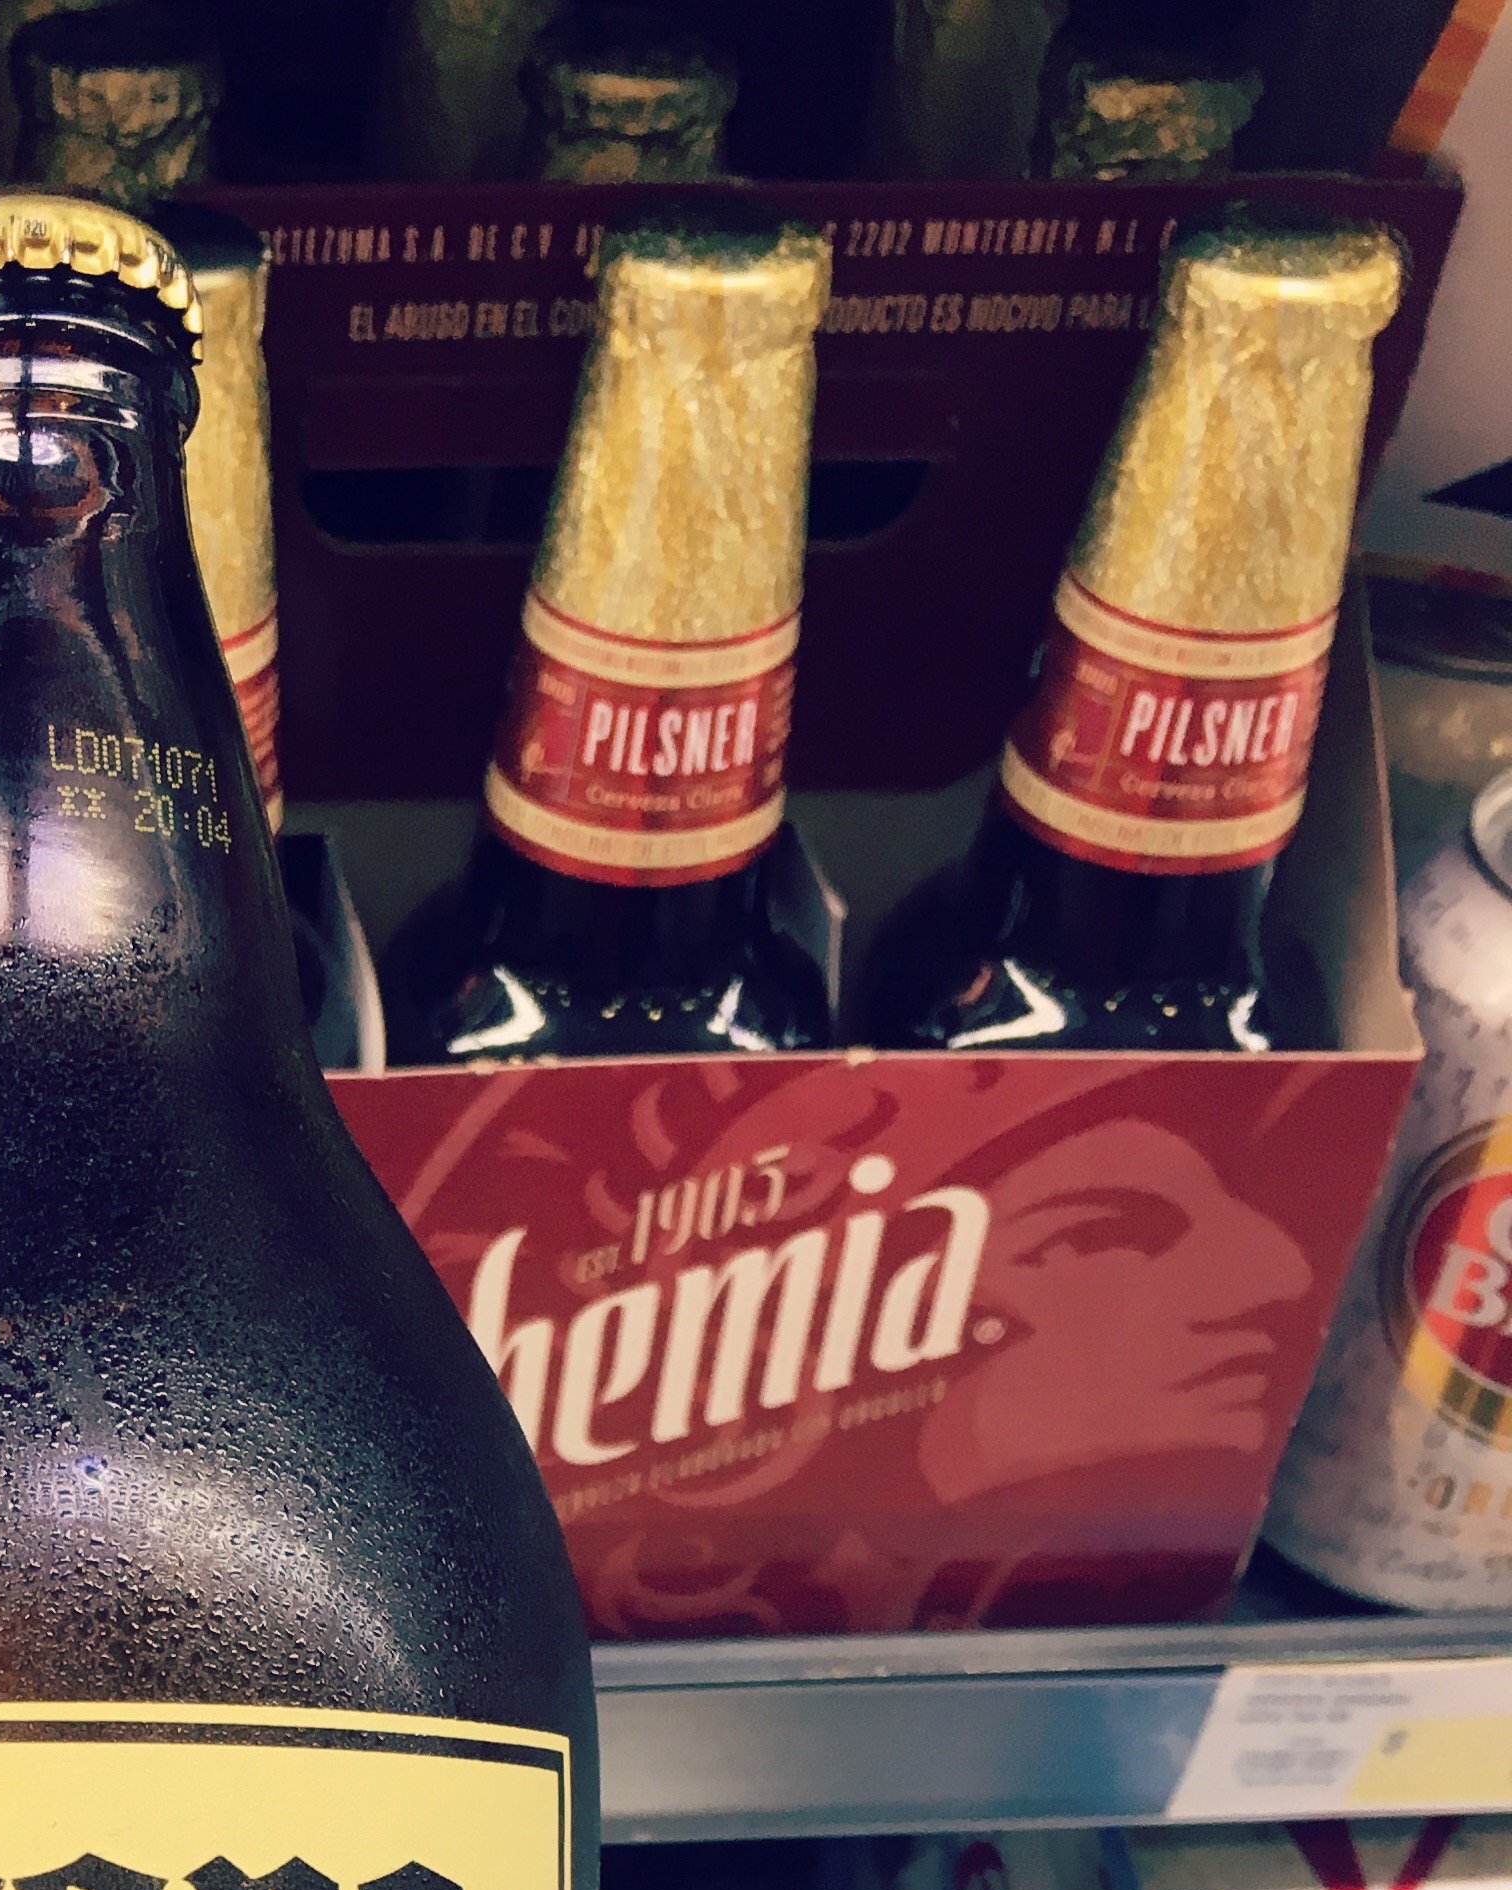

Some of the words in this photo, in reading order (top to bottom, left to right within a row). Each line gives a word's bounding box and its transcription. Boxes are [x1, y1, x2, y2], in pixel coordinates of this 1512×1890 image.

[582, 700, 759, 778] PILSNER
[1119, 691, 1299, 767] PILSNER
[133, 789, 233, 855] 20:04
[466, 1154, 991, 1466] hemia
